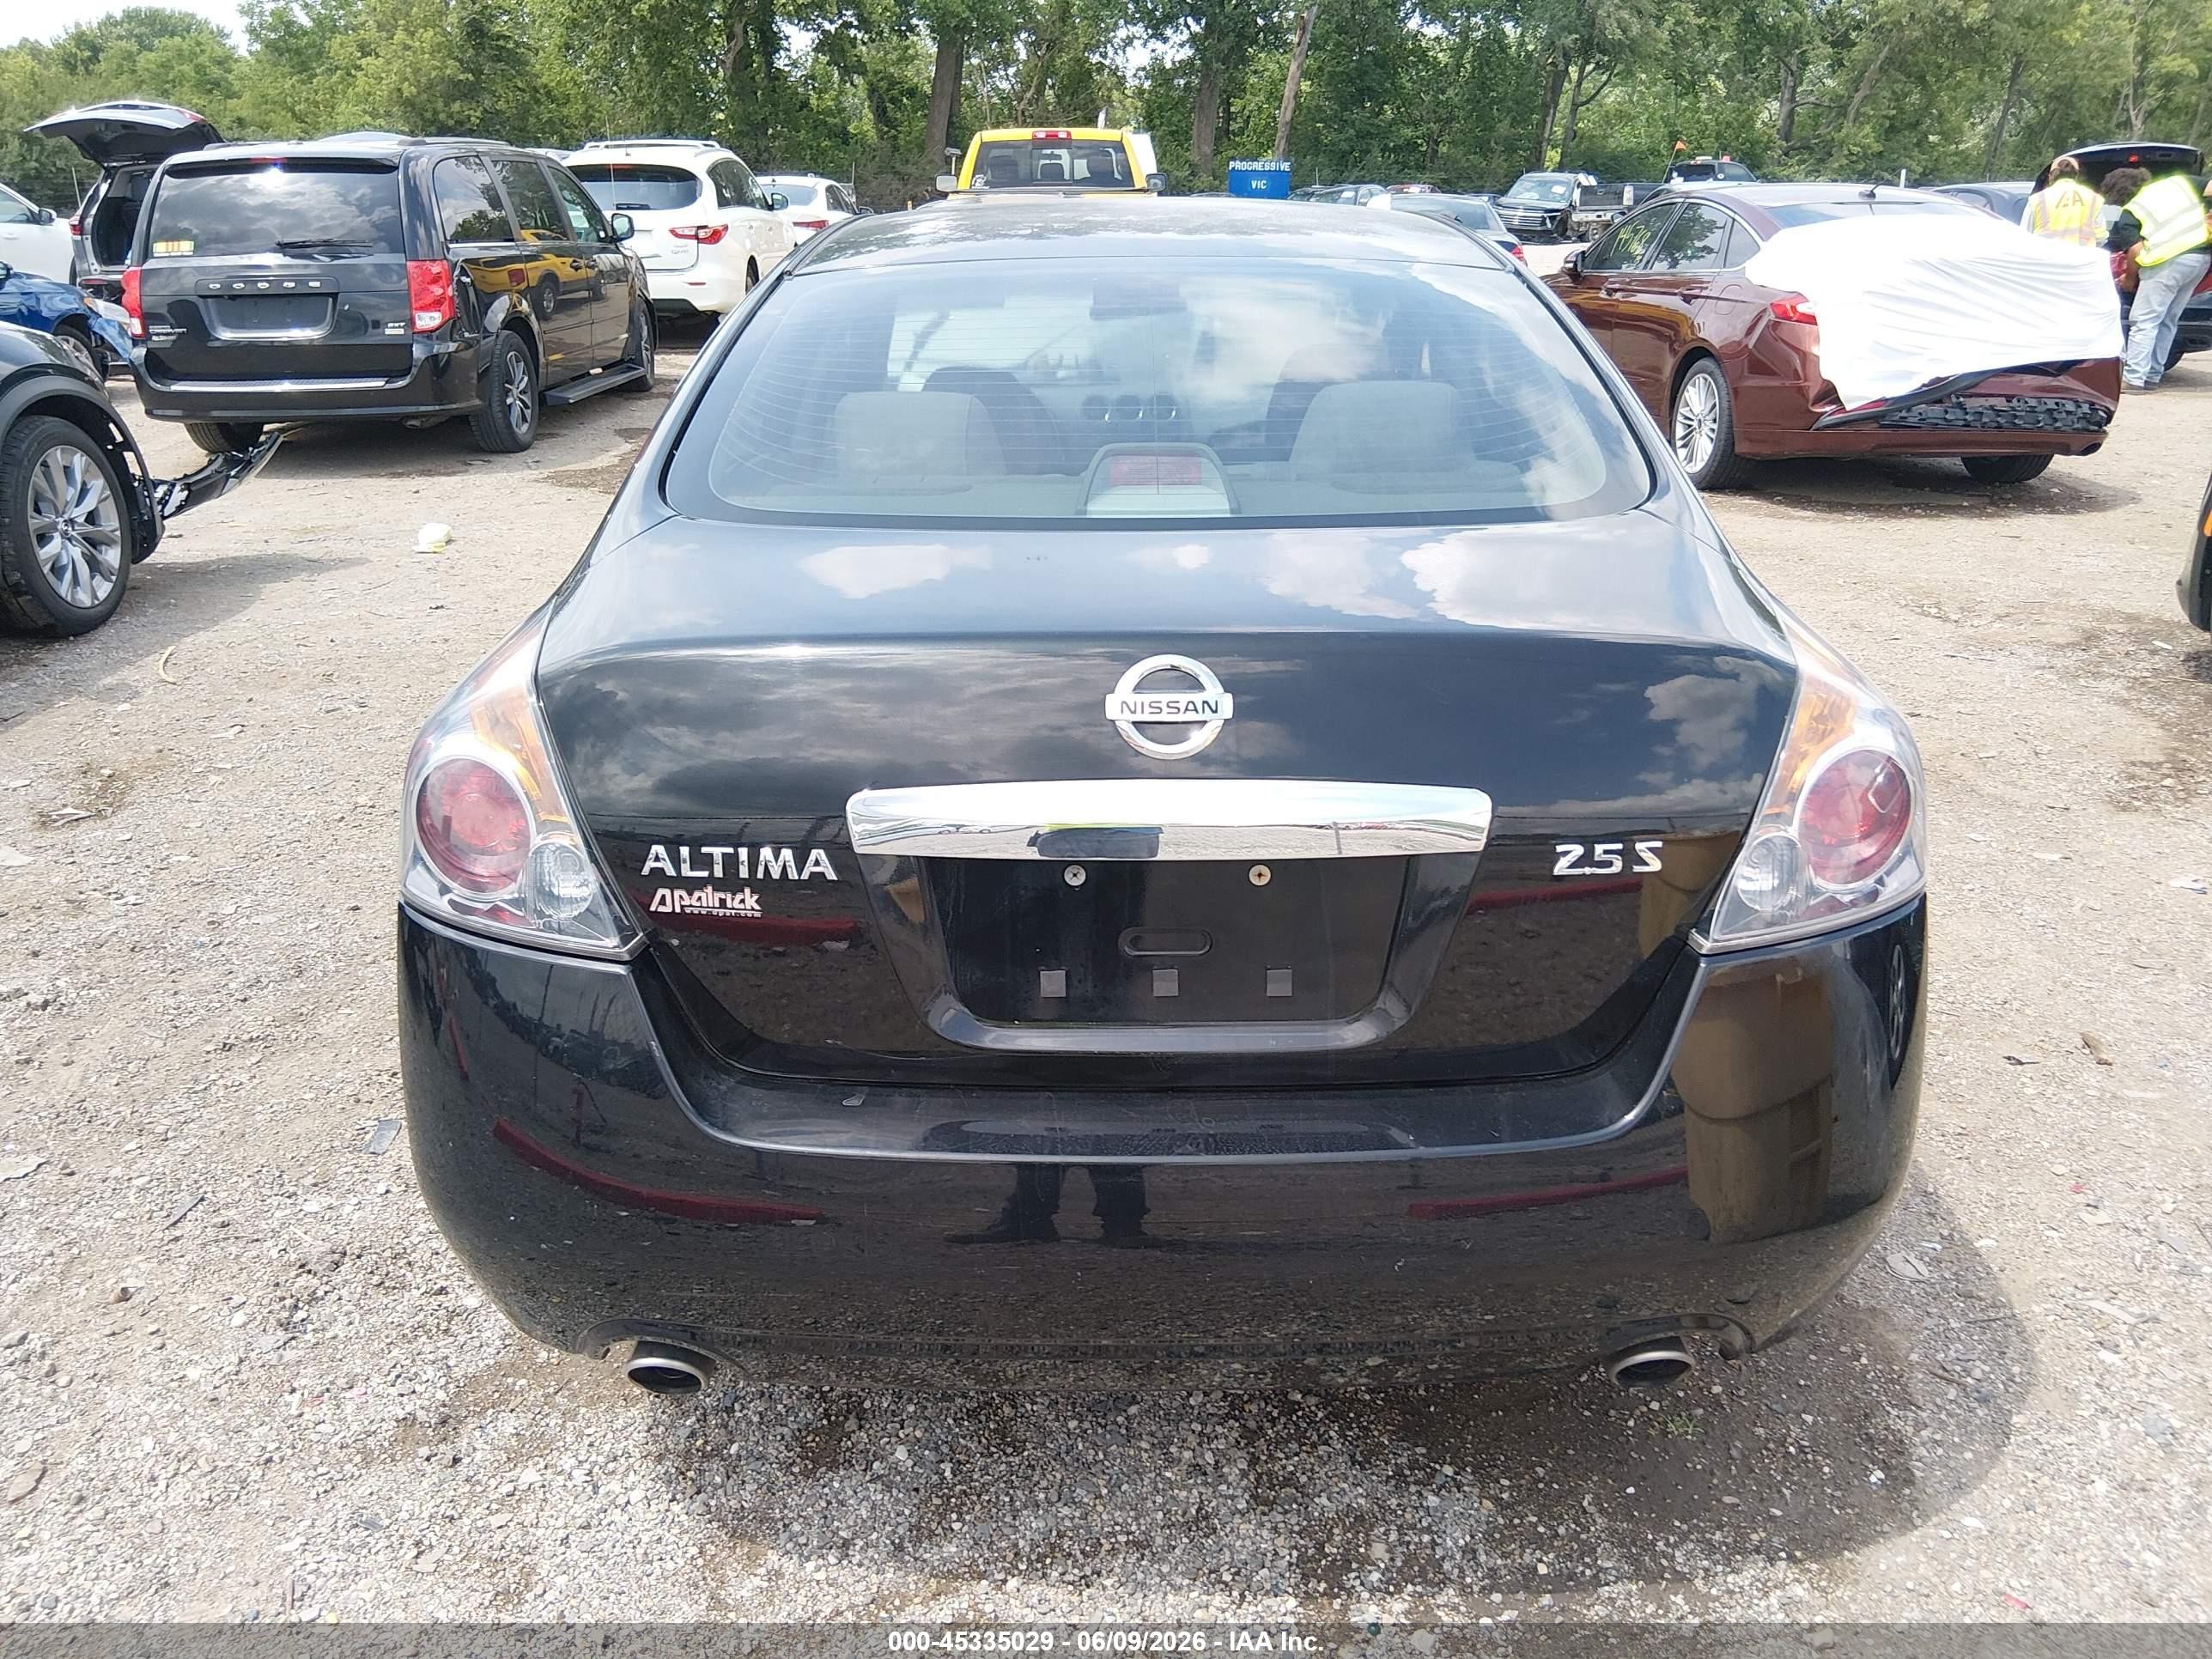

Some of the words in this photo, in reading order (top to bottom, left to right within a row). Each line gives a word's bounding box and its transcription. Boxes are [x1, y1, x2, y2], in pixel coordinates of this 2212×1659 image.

[1229, 161, 1291, 172] PROGRESSIVE
[1251, 179, 1267, 189] VIC
[1120, 700, 1218, 714] NISSAN
[641, 844, 838, 881] ALTIMA
